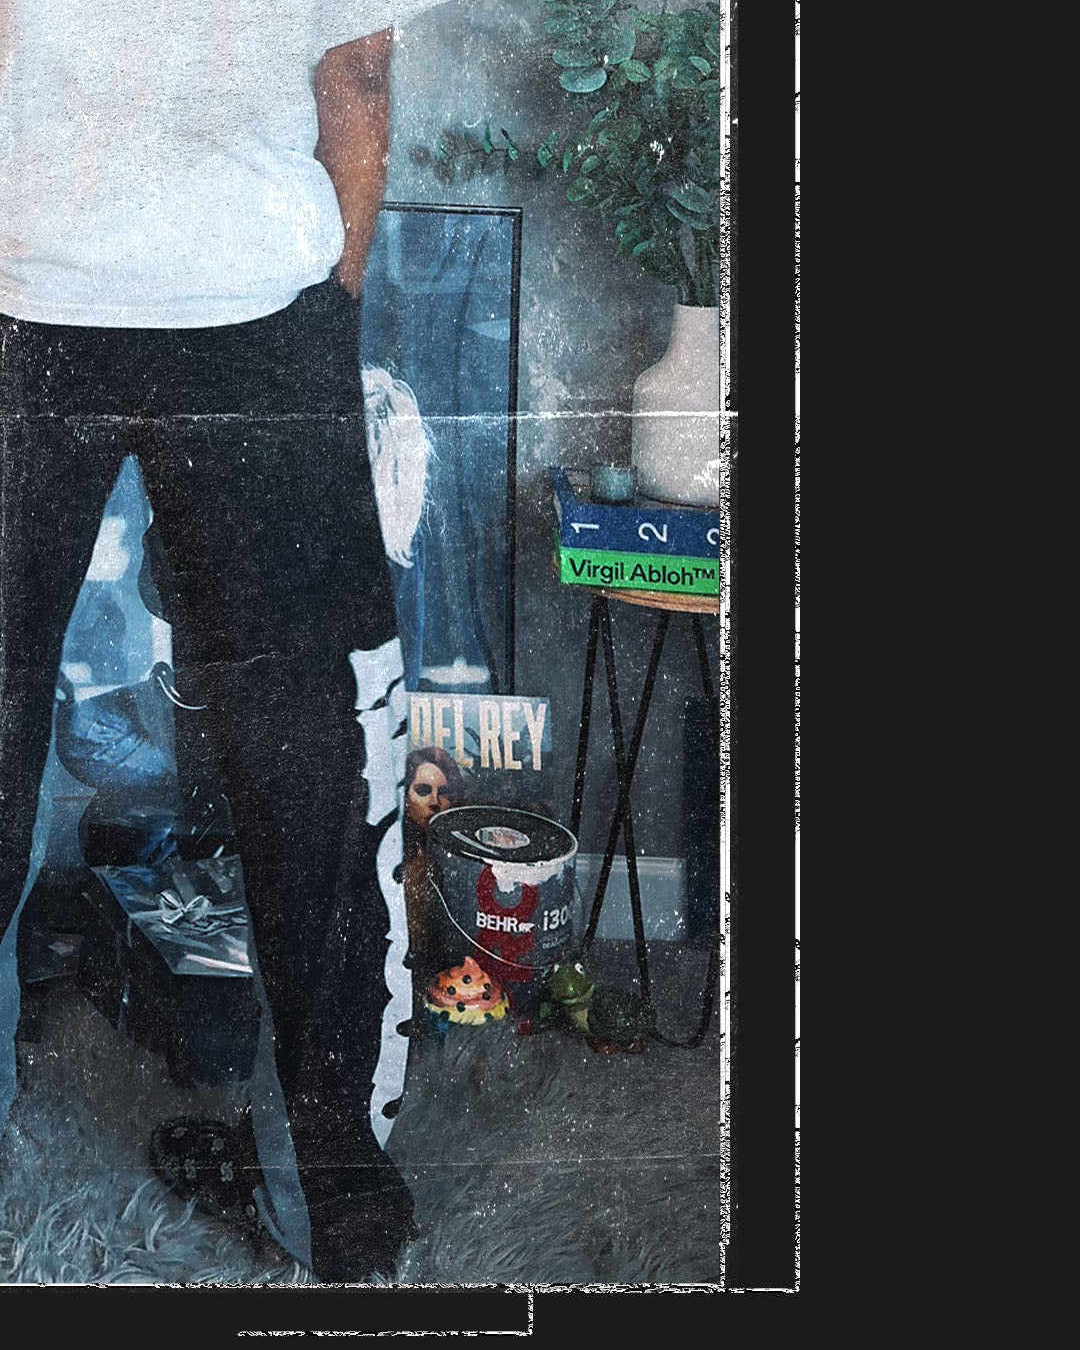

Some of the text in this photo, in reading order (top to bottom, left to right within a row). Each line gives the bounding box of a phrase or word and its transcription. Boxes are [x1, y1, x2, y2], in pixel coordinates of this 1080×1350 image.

[569, 558, 624, 584] Virgil
[479, 700, 547, 770] REY
[476, 911, 518, 932] BEHR
